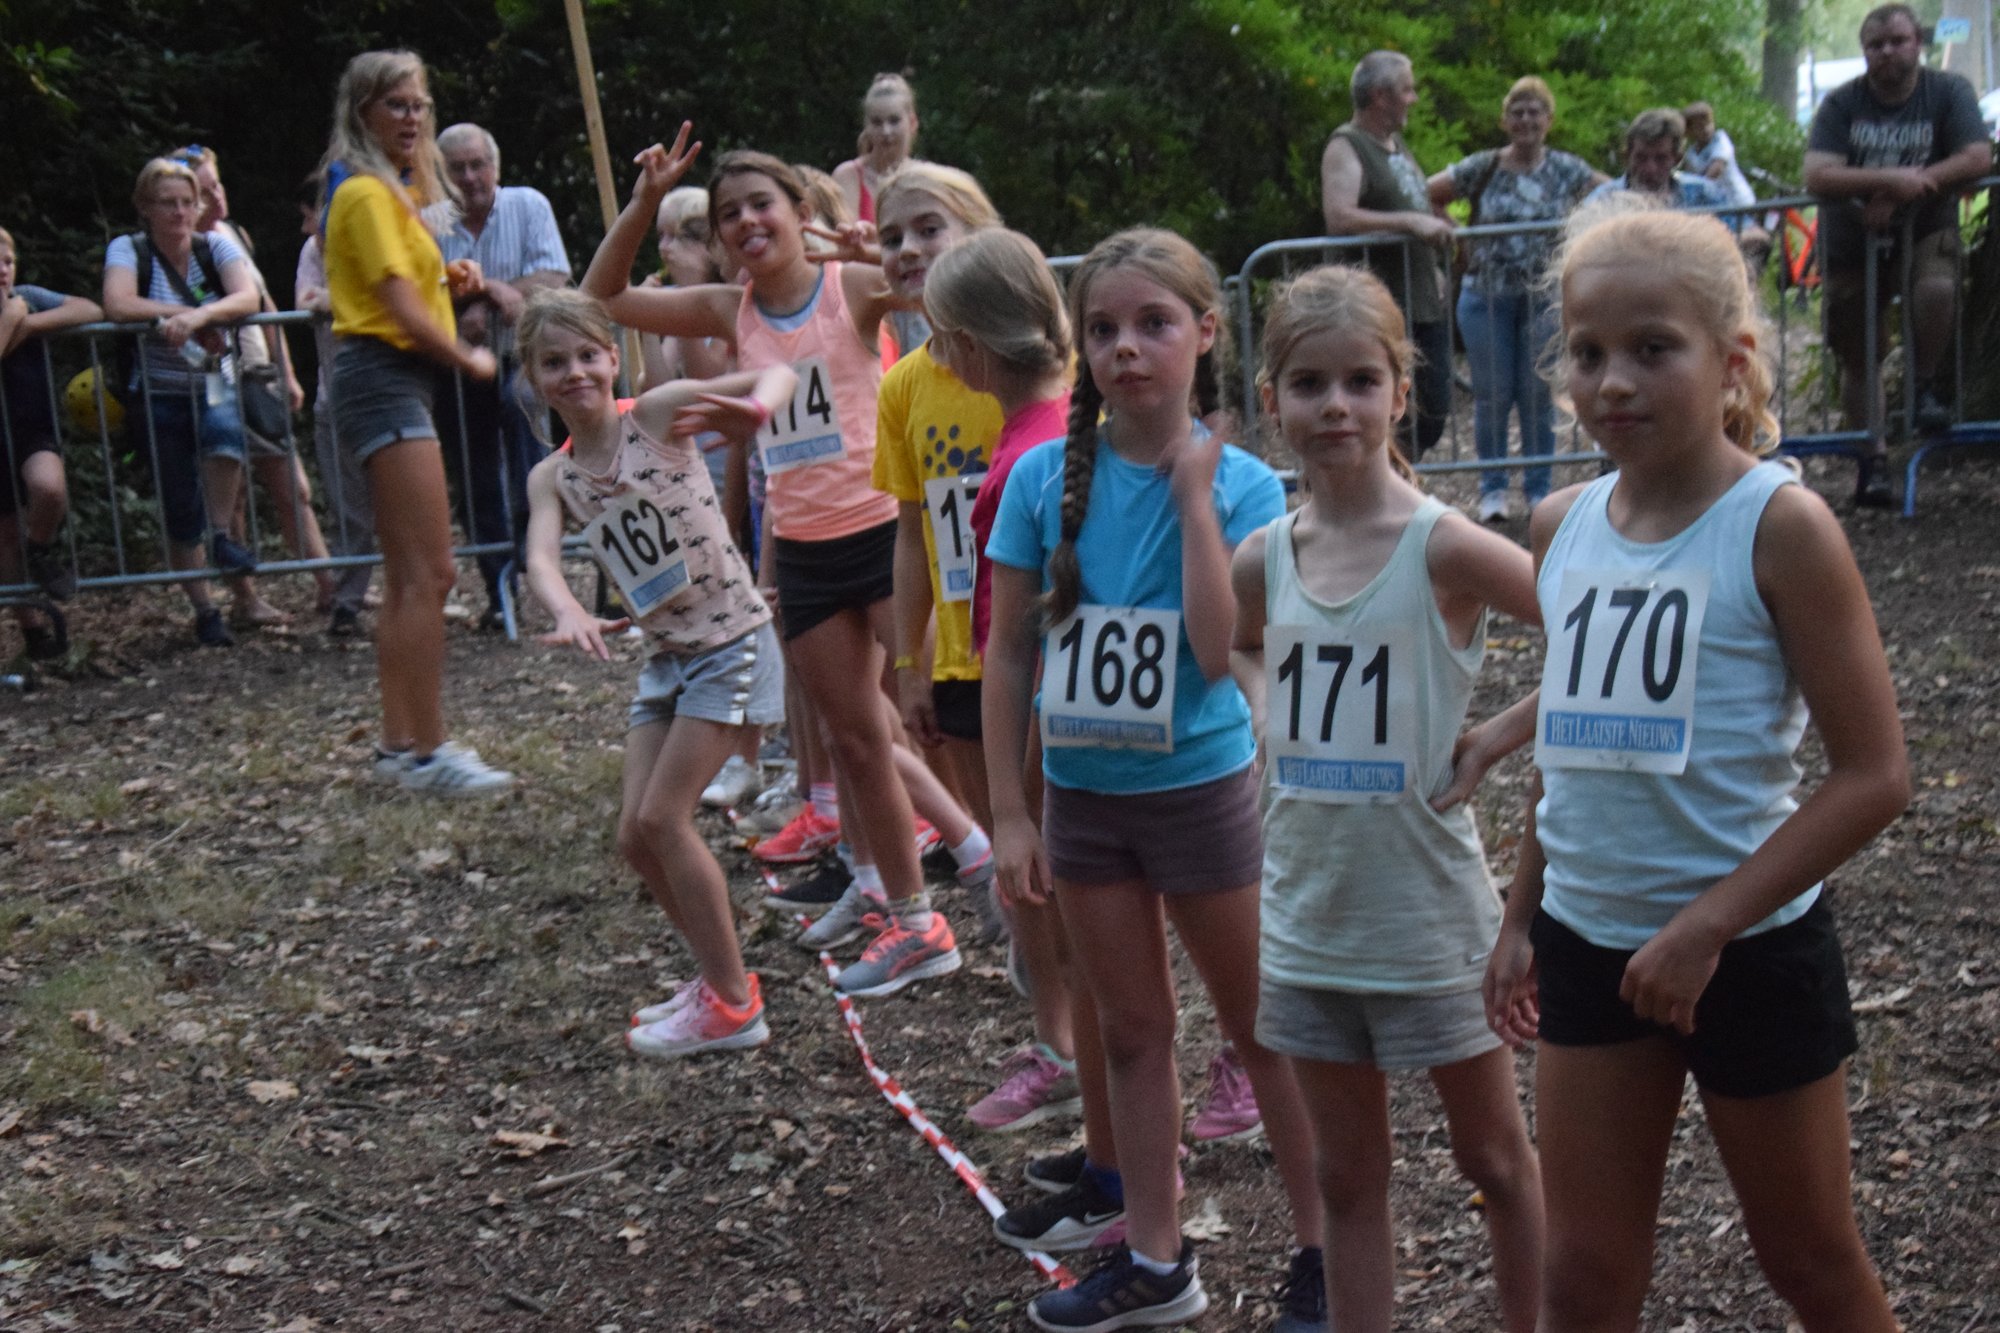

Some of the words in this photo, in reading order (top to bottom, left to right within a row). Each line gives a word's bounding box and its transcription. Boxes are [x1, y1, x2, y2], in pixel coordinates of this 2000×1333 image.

[601, 498, 679, 577] 162
[1059, 618, 1165, 710] 168
[1564, 587, 1689, 703] 170
[1278, 642, 1389, 745] 171
[1551, 715, 1574, 745] HET
[1576, 716, 1625, 747] LAATSTE
[1628, 719, 1679, 750] NIEUWS
